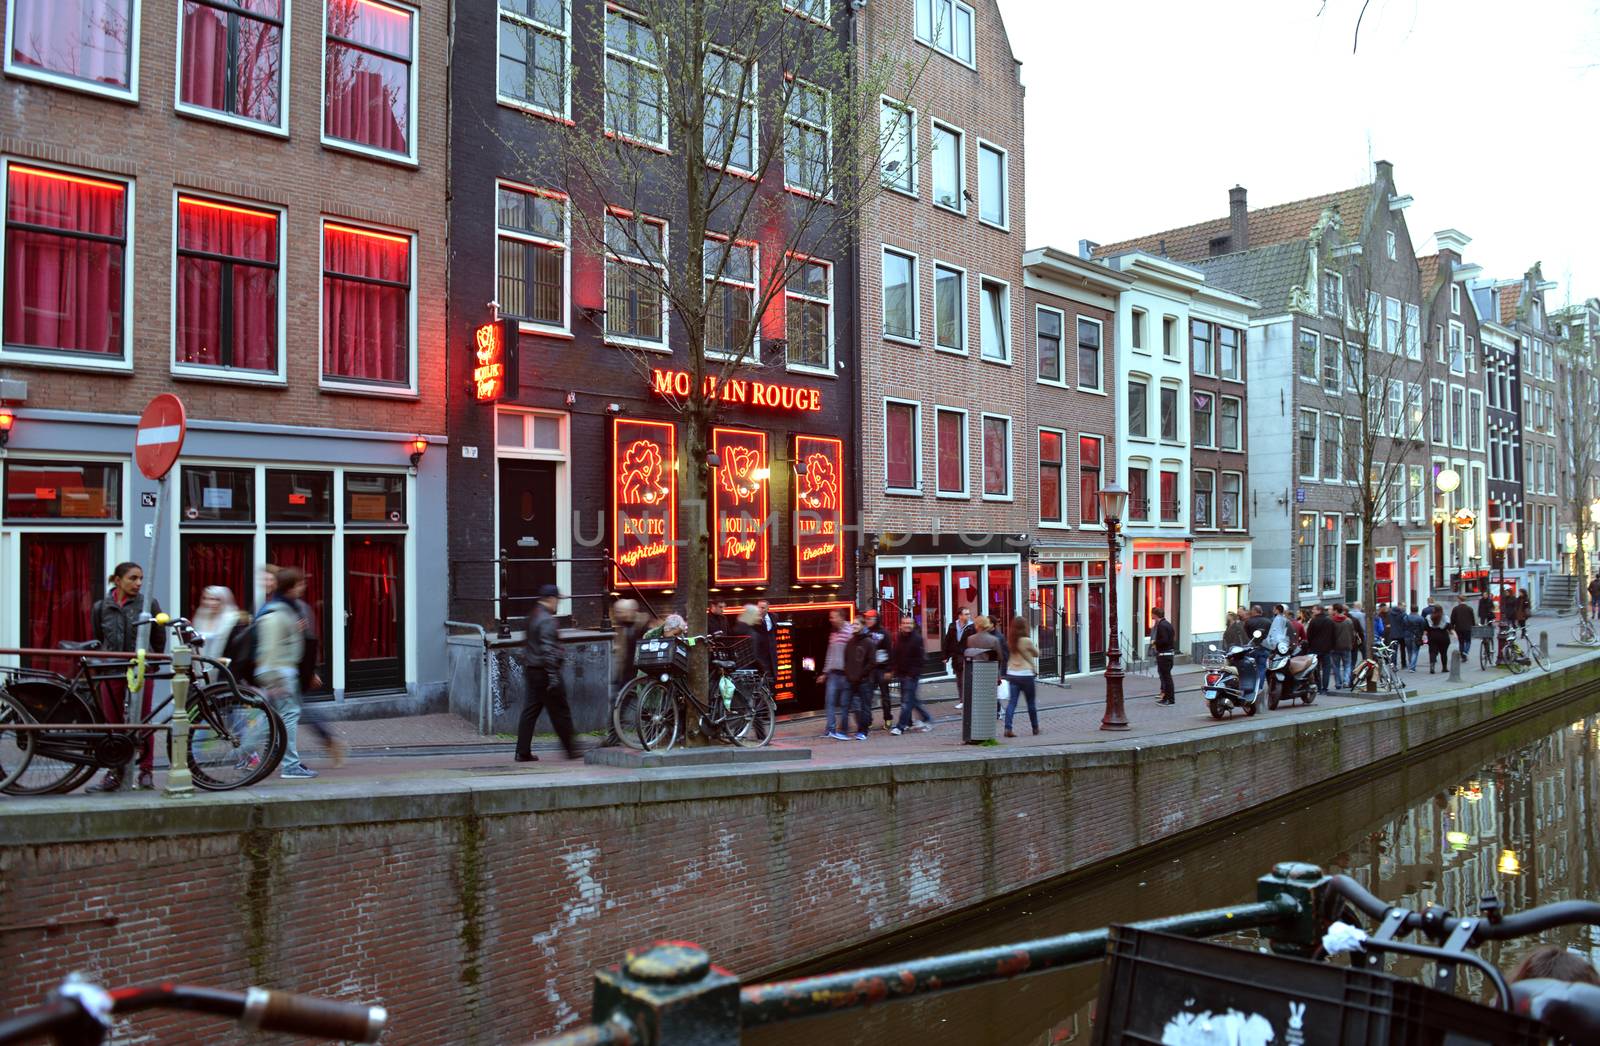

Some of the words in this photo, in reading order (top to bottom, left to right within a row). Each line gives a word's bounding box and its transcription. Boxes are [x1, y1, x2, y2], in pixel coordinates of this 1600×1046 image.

[654, 369, 747, 403] MOLIN
[751, 382, 821, 411] ROUGE
[623, 518, 664, 535] EROTIC
[720, 517, 761, 533] MOULIN
[799, 520, 821, 534] LIVE
[619, 539, 669, 567] nightclub
[726, 536, 757, 560] Rouge
[803, 542, 836, 561] theater
